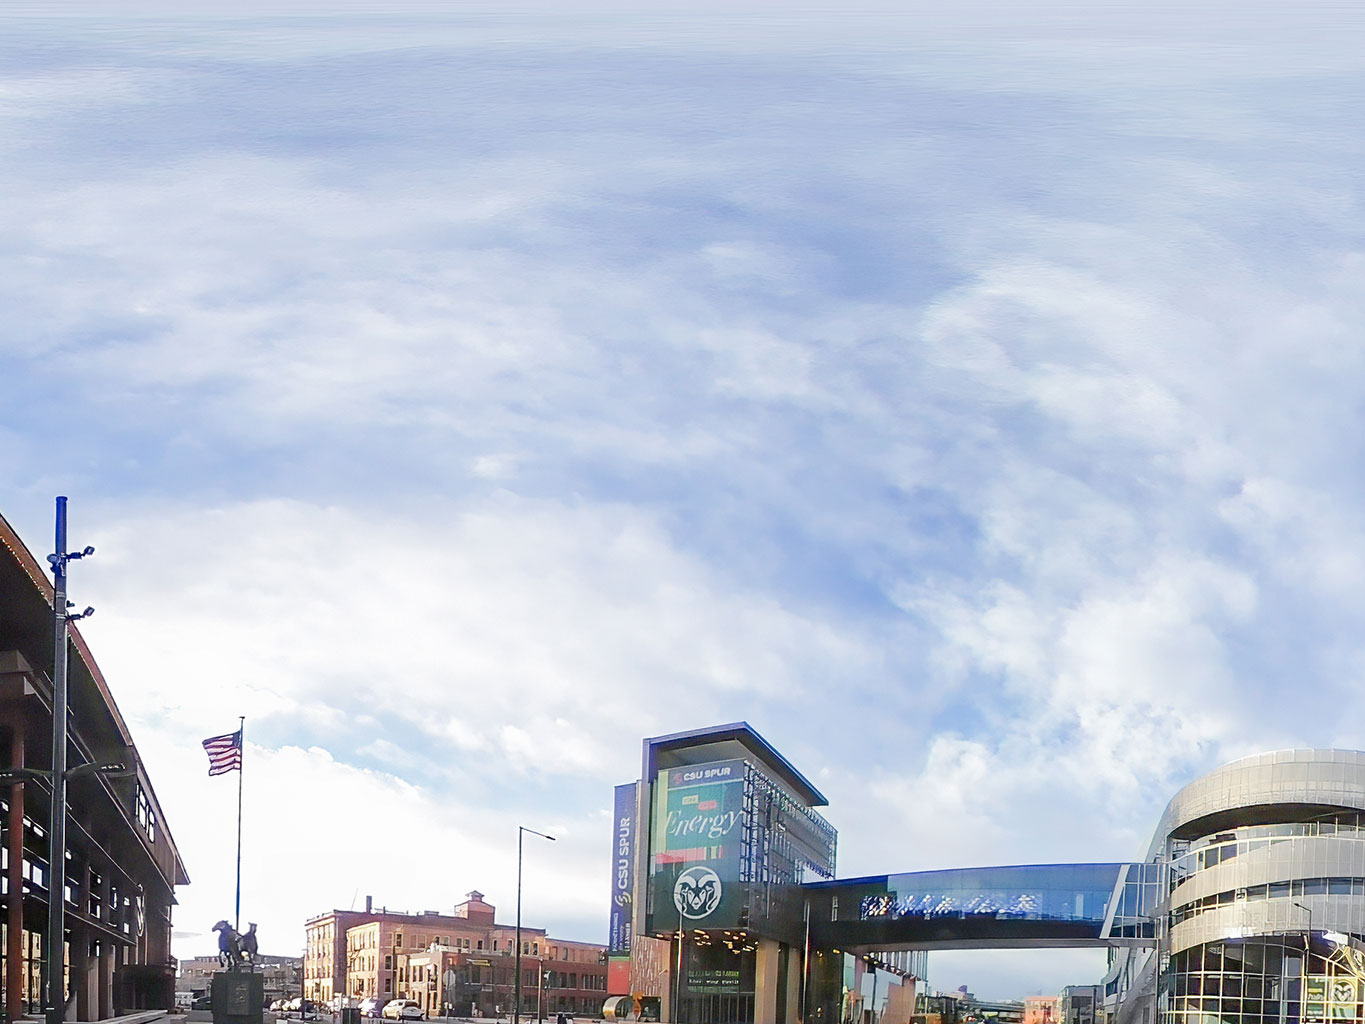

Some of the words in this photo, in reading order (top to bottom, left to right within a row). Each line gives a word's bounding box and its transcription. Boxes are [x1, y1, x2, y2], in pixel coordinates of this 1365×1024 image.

[683, 770, 703, 781] CSU
[704, 767, 731, 778] SPUR
[619, 817, 631, 857] SPUR
[665, 809, 746, 839] Energy
[618, 859, 629, 890] CSU
